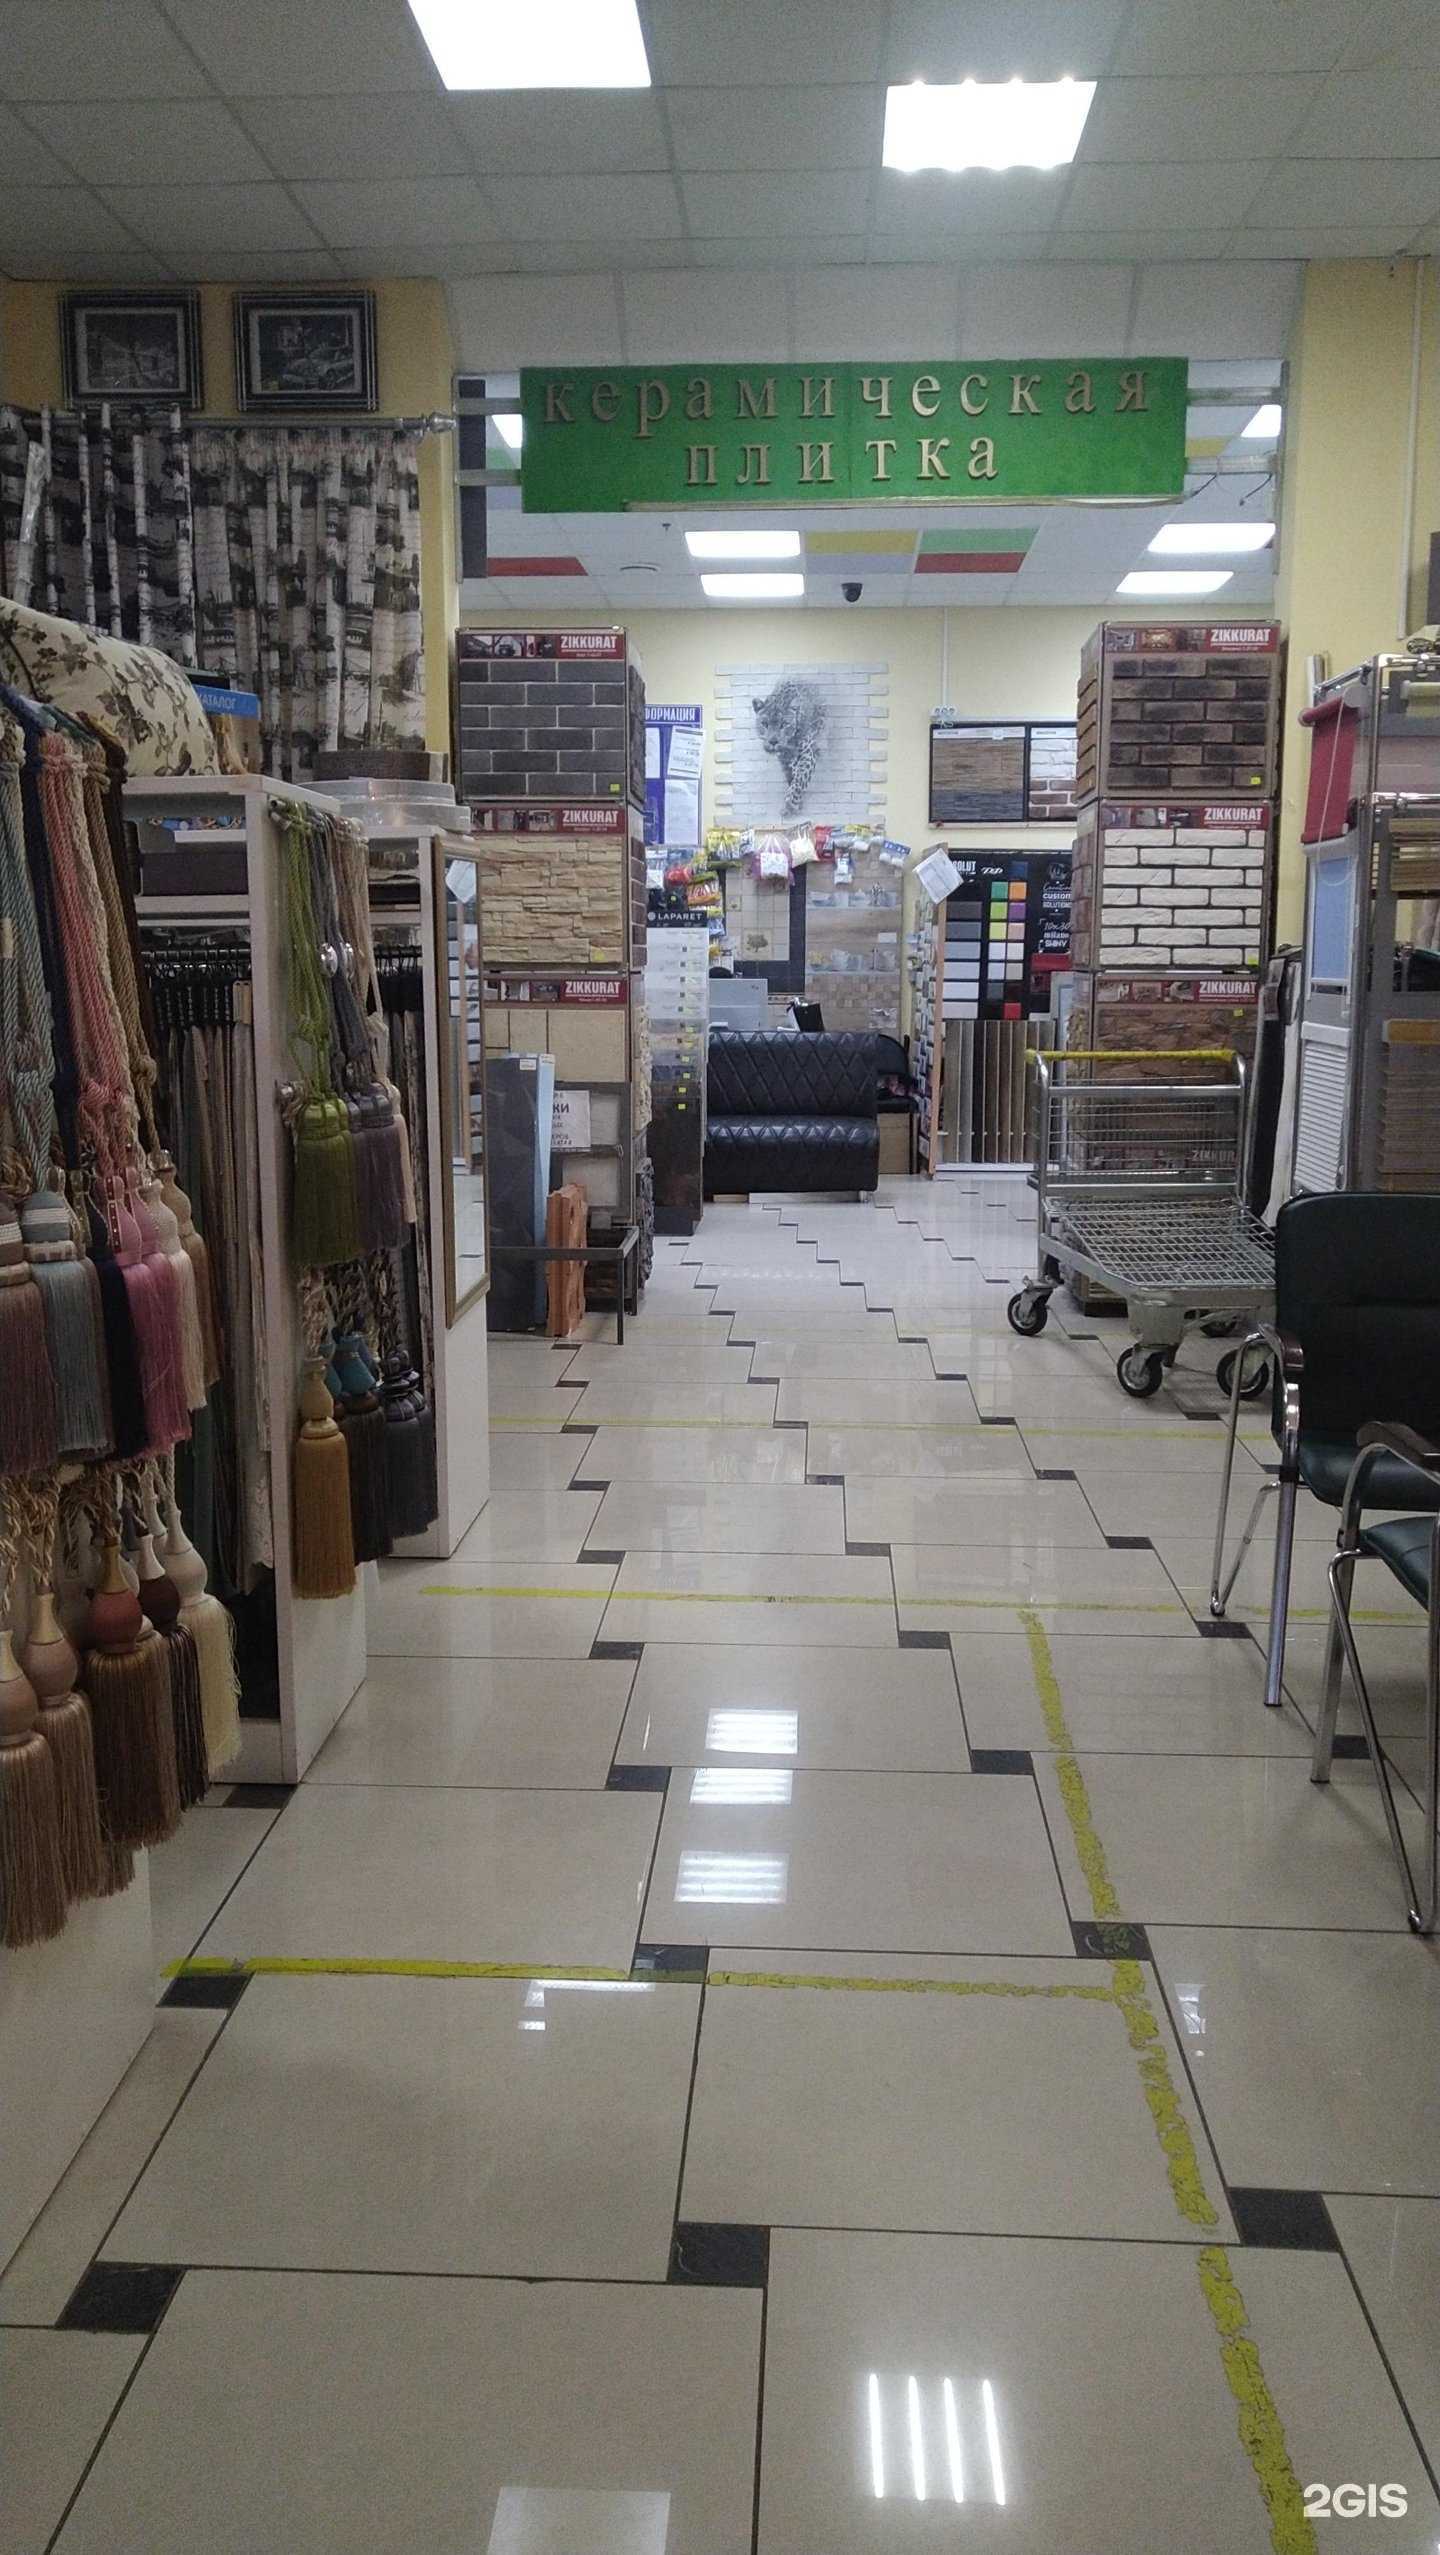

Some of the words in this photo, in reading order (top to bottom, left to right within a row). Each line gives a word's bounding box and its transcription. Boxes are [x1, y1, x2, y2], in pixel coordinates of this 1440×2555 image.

[544, 367, 1149, 439] керамическая
[687, 435, 999, 484] плитка
[560, 635, 618, 649] ZIKKURAT
[1210, 628, 1271, 642] ZIKKURAT
[562, 809, 619, 823] ZIKKURAT
[1204, 807, 1263, 821] ZIKKURAT
[658, 913, 702, 921] LAPARET
[565, 981, 621, 995] ZIKKURAT
[1199, 981, 1257, 994] ZIKKURAT
[1192, 1150, 1238, 1161] ZIKKURA
